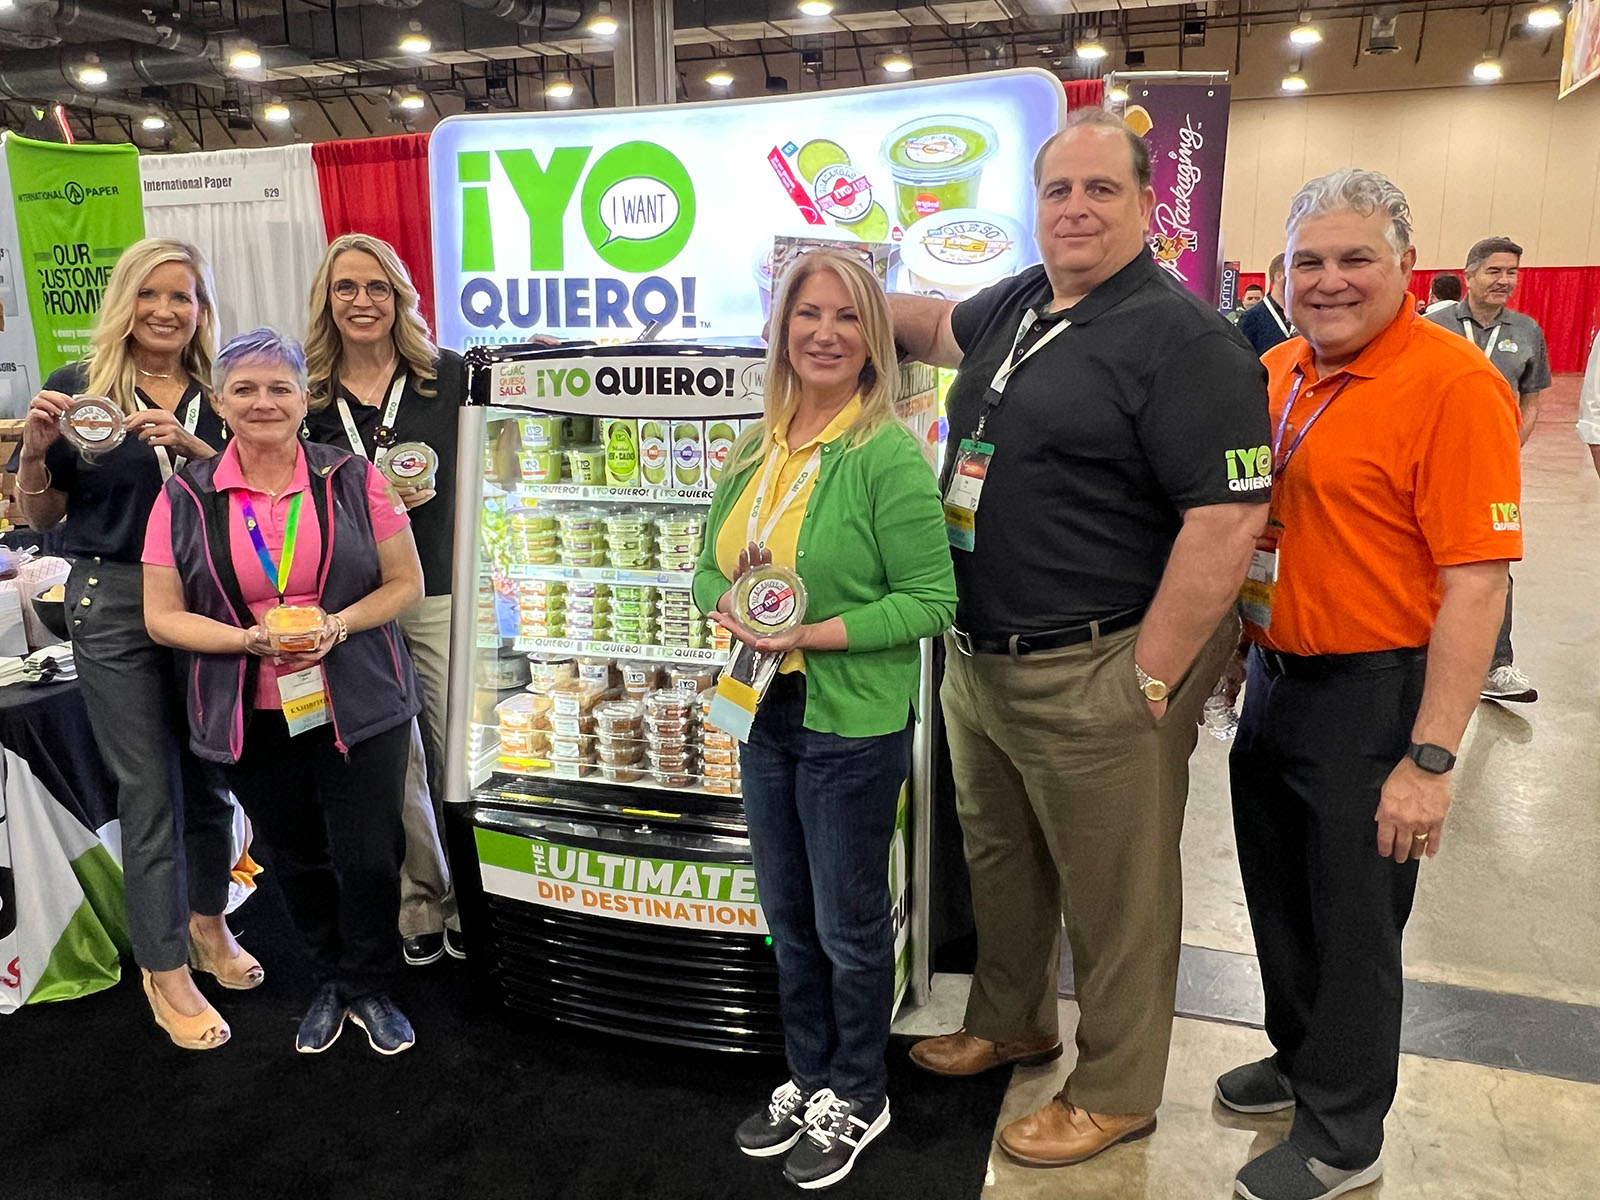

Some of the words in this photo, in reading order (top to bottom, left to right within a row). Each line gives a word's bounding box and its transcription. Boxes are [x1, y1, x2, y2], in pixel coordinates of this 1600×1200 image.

[1156, 113, 1203, 234] Packaging
[144, 177, 202, 191] International
[204, 177, 232, 188] Paper
[85, 186, 119, 197] PAPER
[264, 188, 279, 197] 629
[613, 196, 616, 224] I
[622, 194, 666, 223] WANT
[943, 224, 1000, 240] QUESO
[53, 244, 92, 266] OUR
[461, 276, 697, 329] QUIERO!
[500, 376, 526, 386] QUESO
[595, 366, 735, 397] QUIERO!
[500, 386, 527, 396] SALSA
[791, 471, 809, 492] IFCO
[540, 485, 580, 494] QUIERO!
[609, 488, 649, 496] QUIERO!
[677, 490, 714, 499] QUIERO
[535, 638, 574, 649] QUIERO!
[602, 644, 642, 655] QUIERO!
[674, 649, 716, 660] QUIERO!
[532, 844, 546, 876] THE
[549, 847, 757, 902] ULTIMATE
[538, 880, 575, 902] DIP
[582, 889, 757, 927] DESTINATION
